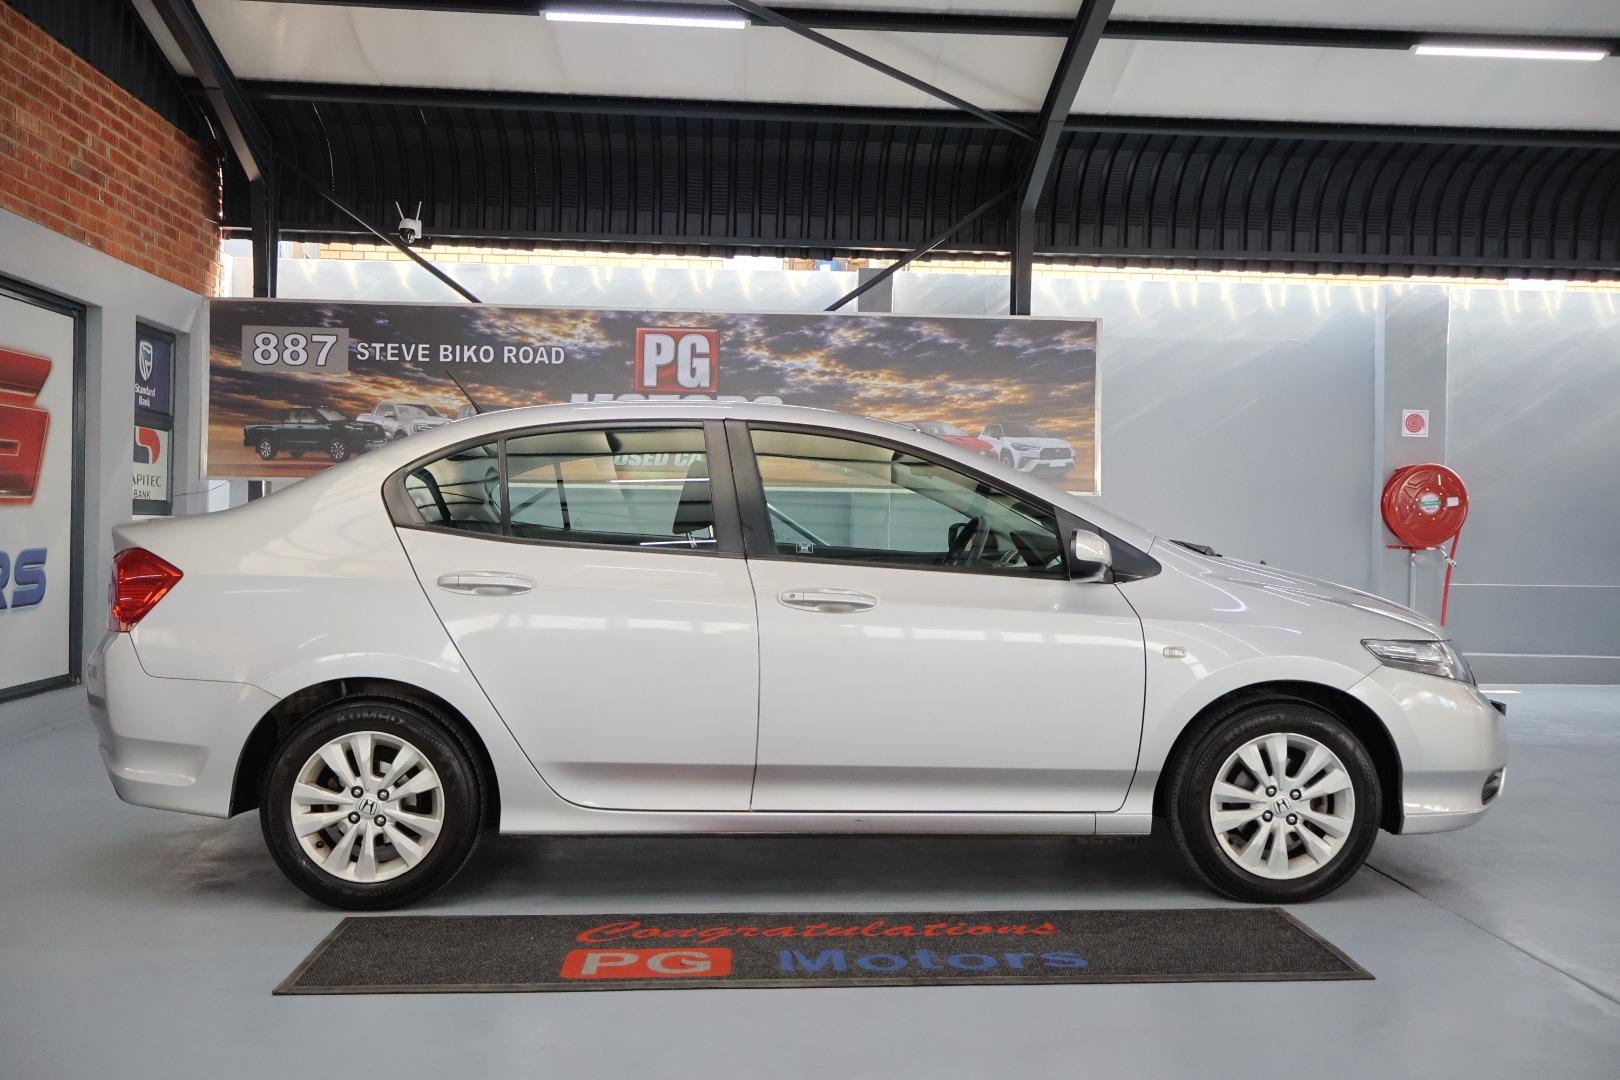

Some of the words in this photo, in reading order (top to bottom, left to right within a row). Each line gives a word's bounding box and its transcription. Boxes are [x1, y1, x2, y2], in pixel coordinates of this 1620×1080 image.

[253, 332, 338, 367] 887
[356, 342, 431, 362] STEVE
[439, 344, 495, 364] BIKO
[503, 345, 566, 365] ROAD
[643, 333, 711, 388] PG
[134, 383, 156, 397] Standard
[138, 395, 151, 407] Bank
[133, 489, 151, 500] BANK
[575, 918, 1058, 945] Congratulations
[580, 951, 712, 975] PG
[779, 948, 1090, 973] Motors
